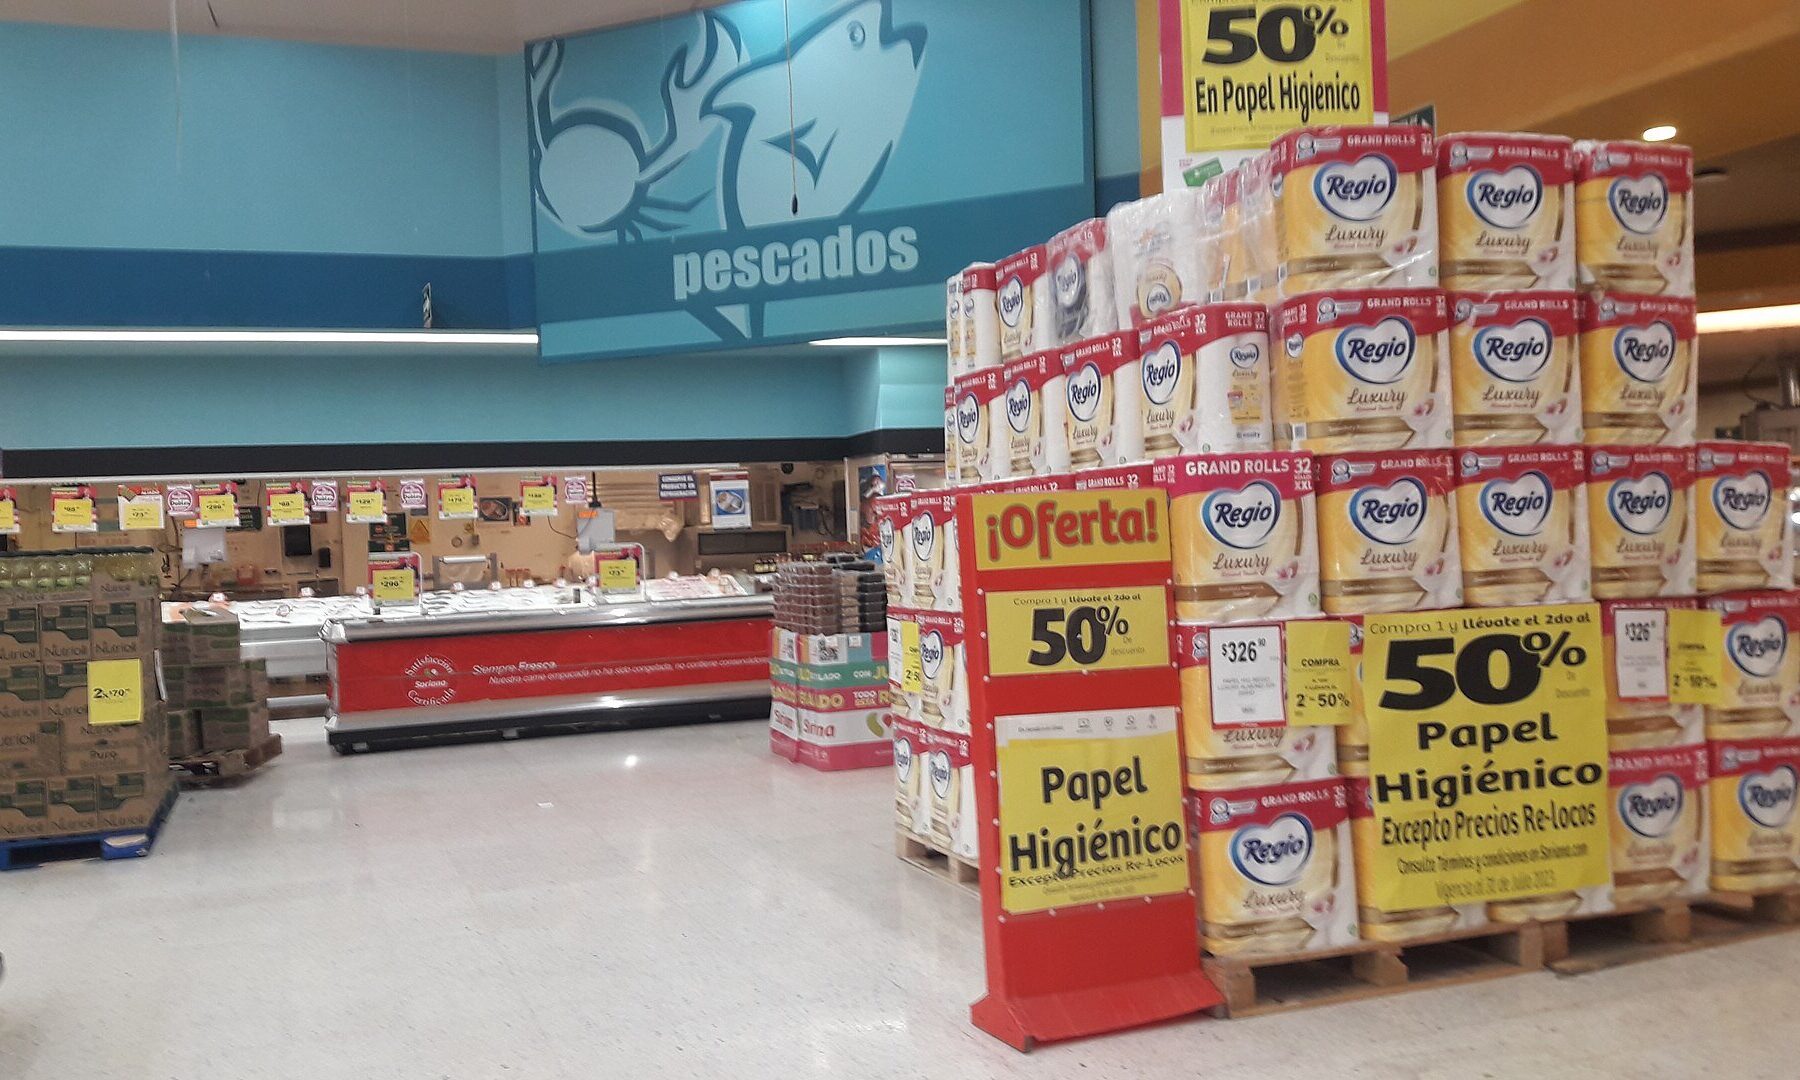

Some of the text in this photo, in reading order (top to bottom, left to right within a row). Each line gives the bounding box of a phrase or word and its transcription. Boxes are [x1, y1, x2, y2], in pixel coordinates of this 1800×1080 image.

[1202, 5, 1349, 64] 50%
[1196, 70, 1360, 123] En Papel Higienico
[1347, 134, 1416, 145] GRAND ROLLS
[1326, 174, 1387, 200] Regio
[1478, 182, 1534, 209] Regio
[1618, 189, 1662, 214] Regio
[1325, 225, 1388, 247] Luxury
[1476, 231, 1532, 254] Luxury
[1617, 237, 1659, 259] Luxury
[673, 225, 919, 300] pescados
[1367, 296, 1431, 308] GRAND ROLLS
[1505, 300, 1568, 311] GRAND ROLLS
[1195, 314, 1206, 324] 32
[1226, 311, 1252, 319] GRAND
[1228, 318, 1251, 327] ROLLS
[1112, 337, 1122, 346] 32
[1348, 337, 1406, 363] Regio
[1487, 337, 1544, 362] Regio
[1624, 337, 1669, 362] Regio
[1147, 357, 1175, 386] Regio
[1071, 378, 1096, 405] Regio
[1347, 388, 1408, 410] Luxury
[1483, 385, 1541, 408] Luxury
[1620, 385, 1666, 408] Luxury
[1009, 395, 1028, 416] Regio
[959, 409, 976, 428] Regio
[1146, 408, 1175, 427] Luxury
[1073, 424, 1098, 442] Luxury
[1186, 459, 1289, 475] GRAND ROLLS
[1294, 458, 1311, 474] 32
[1380, 457, 1441, 469] GRAND ROLLS
[1507, 452, 1568, 463] GRAND ROLLS
[1104, 475, 1124, 486] ROLLS
[1127, 474, 1138, 485] 32
[1362, 498, 1418, 524] Regio
[1492, 492, 1543, 516] Regio
[1618, 490, 1666, 515] Regio
[1723, 487, 1765, 512] Regio
[1215, 500, 1272, 528] Regio
[915, 527, 931, 545] Regio
[986, 497, 1158, 562] ¡Oferta!
[1360, 549, 1419, 572] Luxury
[1493, 539, 1548, 561] Luxury
[1616, 537, 1665, 561] Luxury
[1212, 553, 1272, 575] Luxury
[1103, 594, 1112, 602] el
[1114, 594, 1130, 602] 2do
[1133, 593, 1142, 601] al
[1369, 612, 1590, 635] Compra 1 y llévate el 2do al
[1028, 606, 1129, 666] 50%
[1737, 633, 1781, 657] Regio
[1221, 640, 1258, 663] $326
[1301, 658, 1340, 667] COMPRA
[1379, 631, 1587, 711] 50%
[1417, 712, 1560, 753] Papel
[1042, 756, 1148, 810] Papel
[1376, 760, 1603, 808] Higiénico
[1381, 811, 1451, 850] Excepto
[1455, 804, 1518, 839] Precios
[1009, 816, 1182, 881] Higiénico
[1243, 833, 1304, 865] Regio
